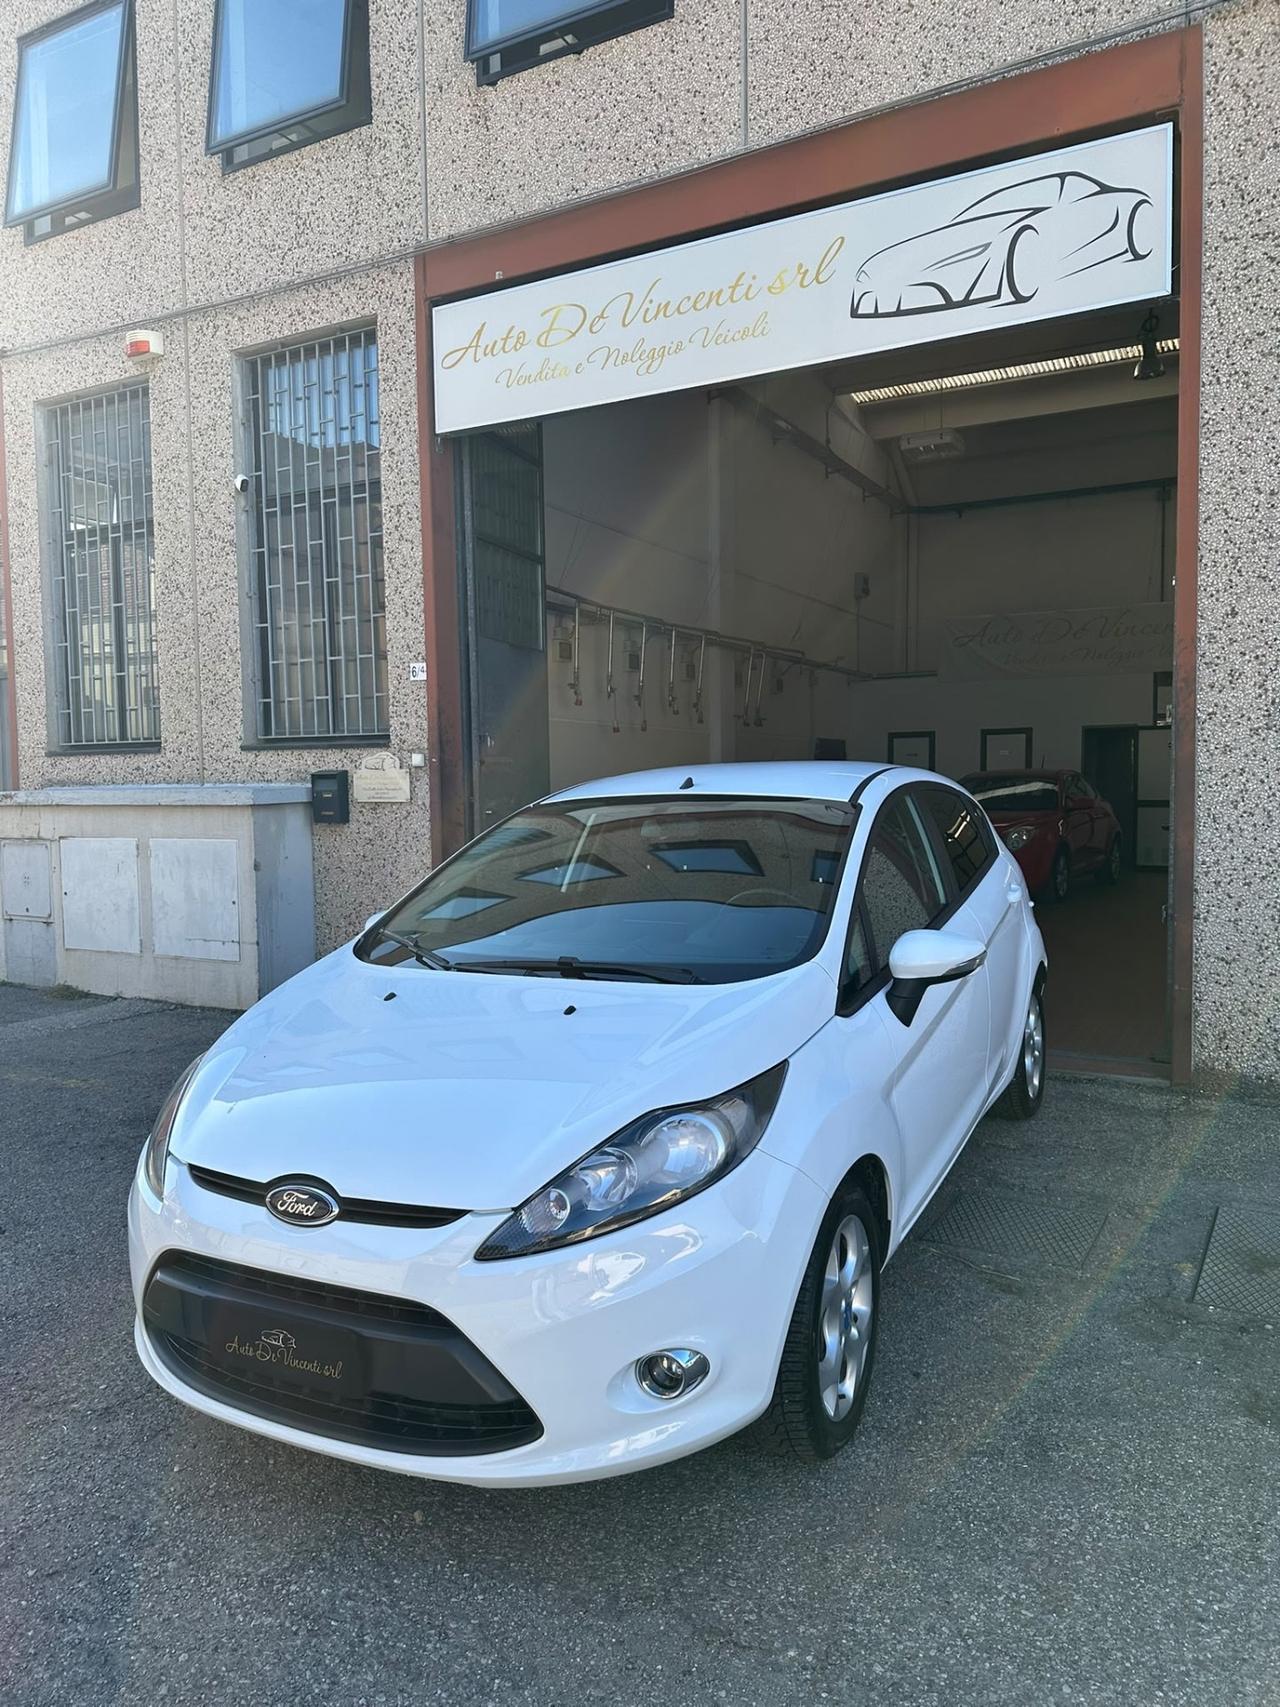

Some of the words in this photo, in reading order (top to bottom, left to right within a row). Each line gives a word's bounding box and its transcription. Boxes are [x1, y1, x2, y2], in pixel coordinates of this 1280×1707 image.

[441, 321, 530, 370] Auto
[536, 303, 605, 348] De
[606, 278, 760, 325] Vincenti
[767, 235, 846, 295] srl
[495, 358, 569, 389] Vendita
[575, 362, 585, 374] e
[586, 337, 684, 376] Noleggio
[689, 311, 770, 349] Veicoli
[412, 666, 424, 678] 6/4
[277, 1190, 318, 1216] Ford
[225, 1336, 255, 1357] Auto
[323, 1361, 343, 1379] srl
